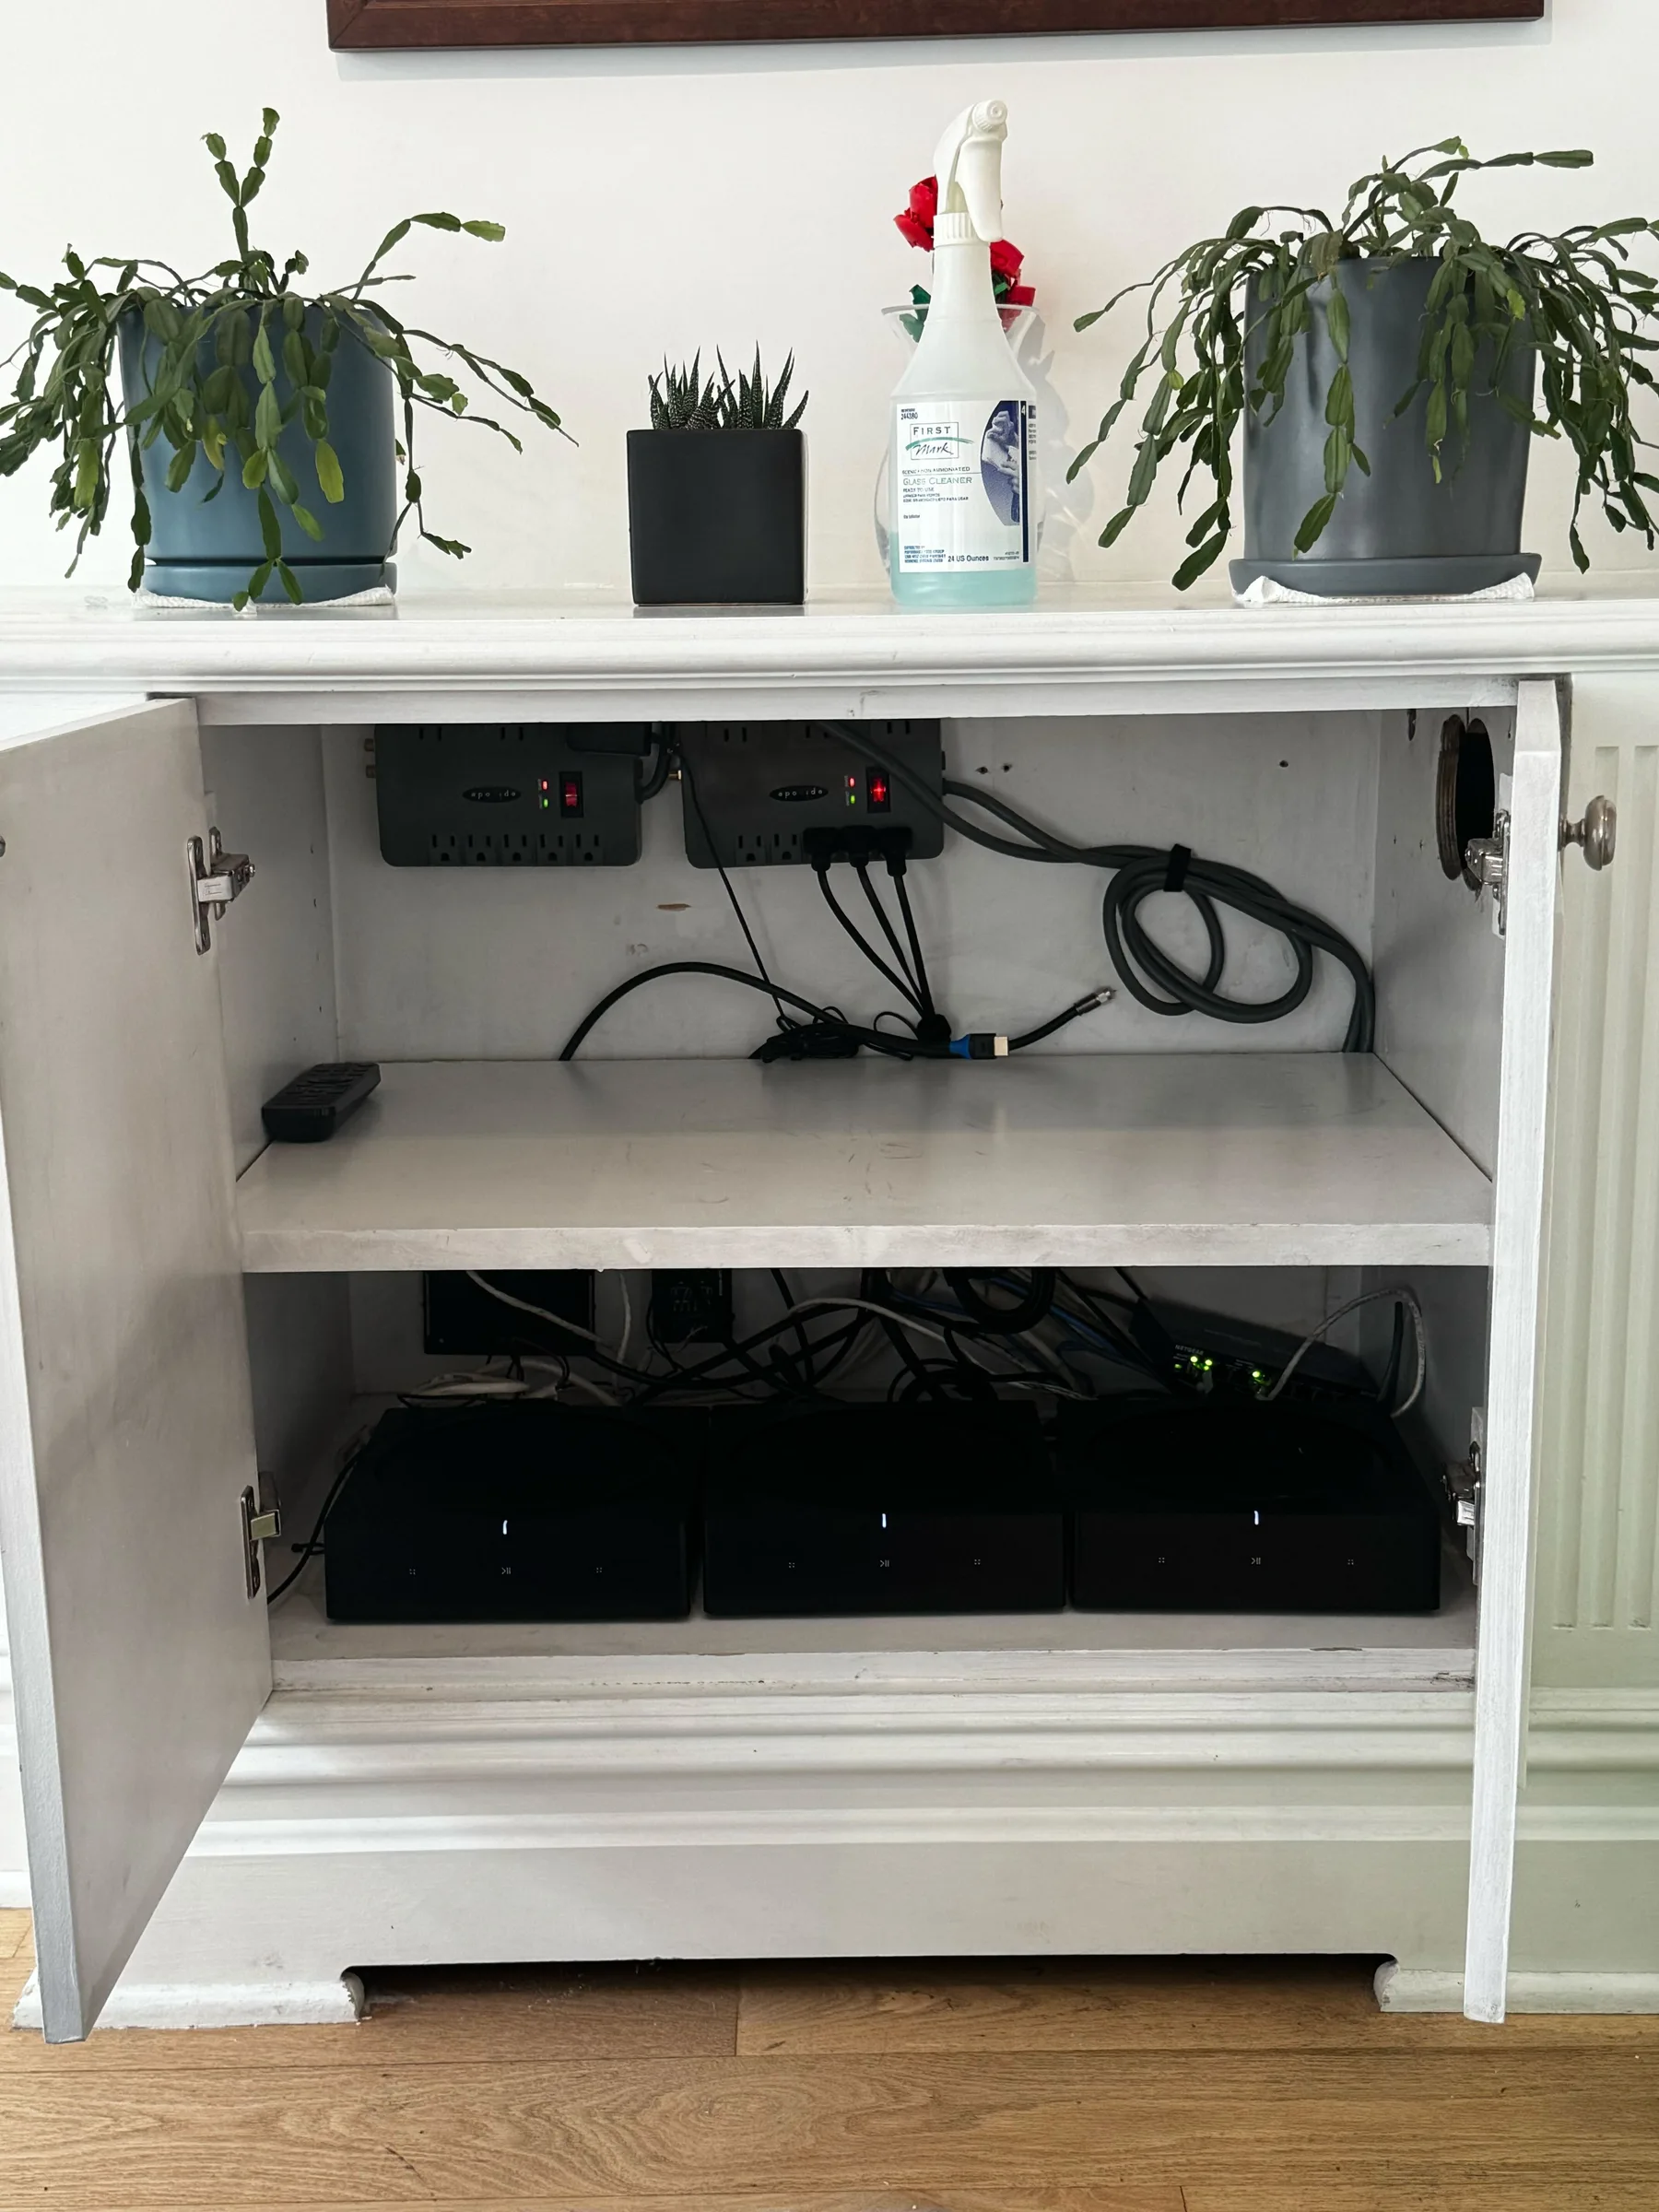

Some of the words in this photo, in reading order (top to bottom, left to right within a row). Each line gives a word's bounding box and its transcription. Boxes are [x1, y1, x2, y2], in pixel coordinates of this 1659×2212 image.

[913, 426, 951, 435] FIRST
[912, 442, 954, 455] Mark
[903, 477, 926, 486] GLASS
[929, 477, 972, 485] CLEANER
[966, 554, 990, 562] Ounces
[470, 789, 516, 800] epiode
[777, 787, 823, 799] epiode
